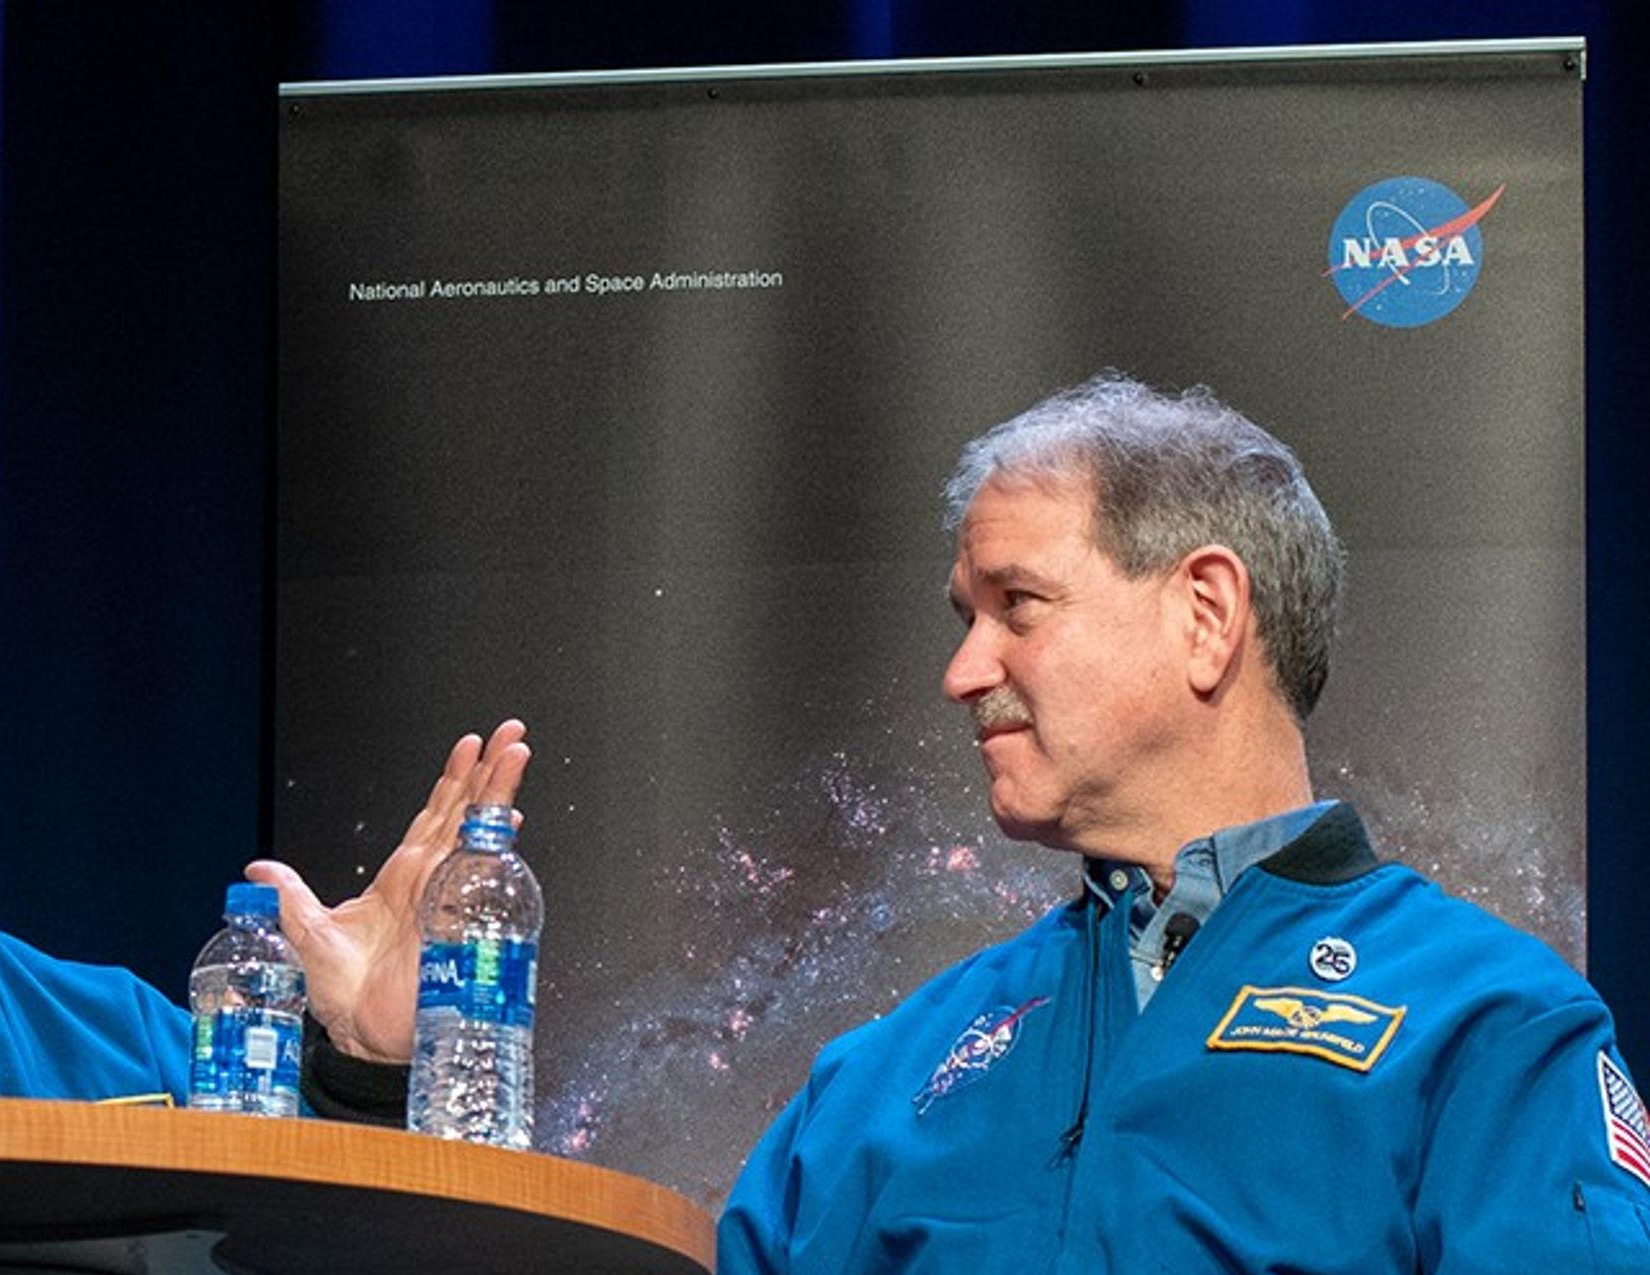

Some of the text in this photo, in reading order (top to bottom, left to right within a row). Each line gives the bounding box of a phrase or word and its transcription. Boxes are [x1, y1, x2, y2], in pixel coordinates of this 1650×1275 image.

[1342, 234, 1474, 269] NASA
[350, 269, 783, 300] National Aeronautics and Space Administration
